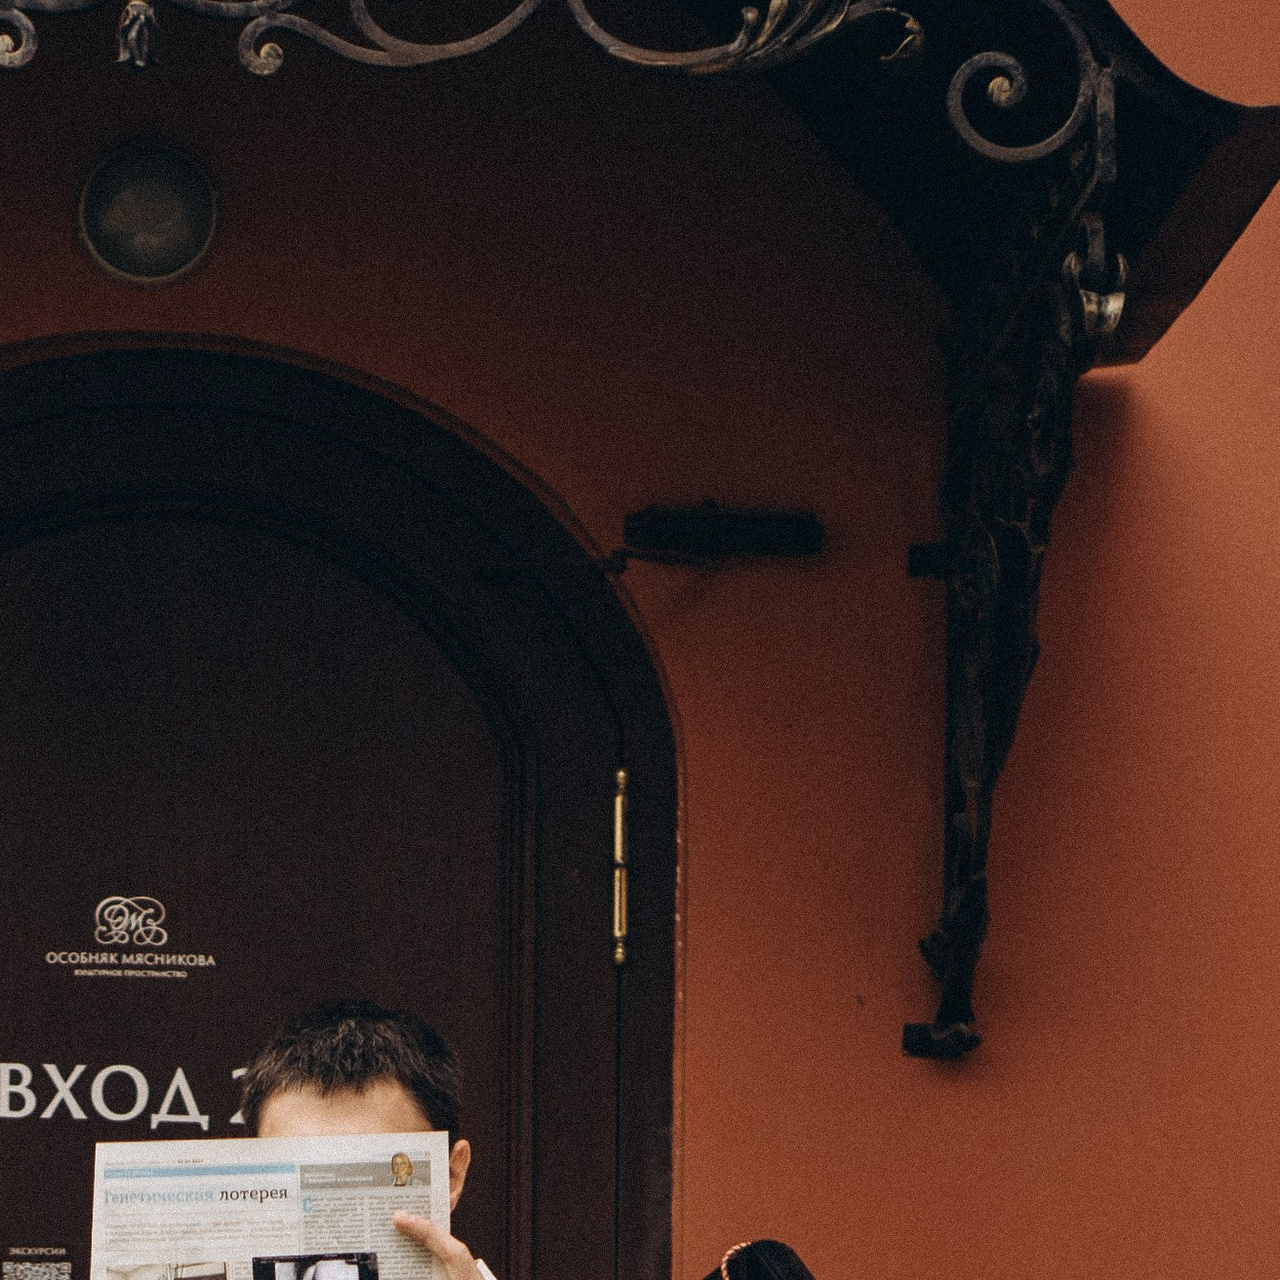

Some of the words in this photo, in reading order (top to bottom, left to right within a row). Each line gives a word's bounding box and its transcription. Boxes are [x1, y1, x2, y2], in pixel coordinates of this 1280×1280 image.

[46, 952, 119, 964] ОСОБНЯК
[121, 953, 216, 966] МЯСНИКОВА
[220, 1188, 288, 1203] лотерея
